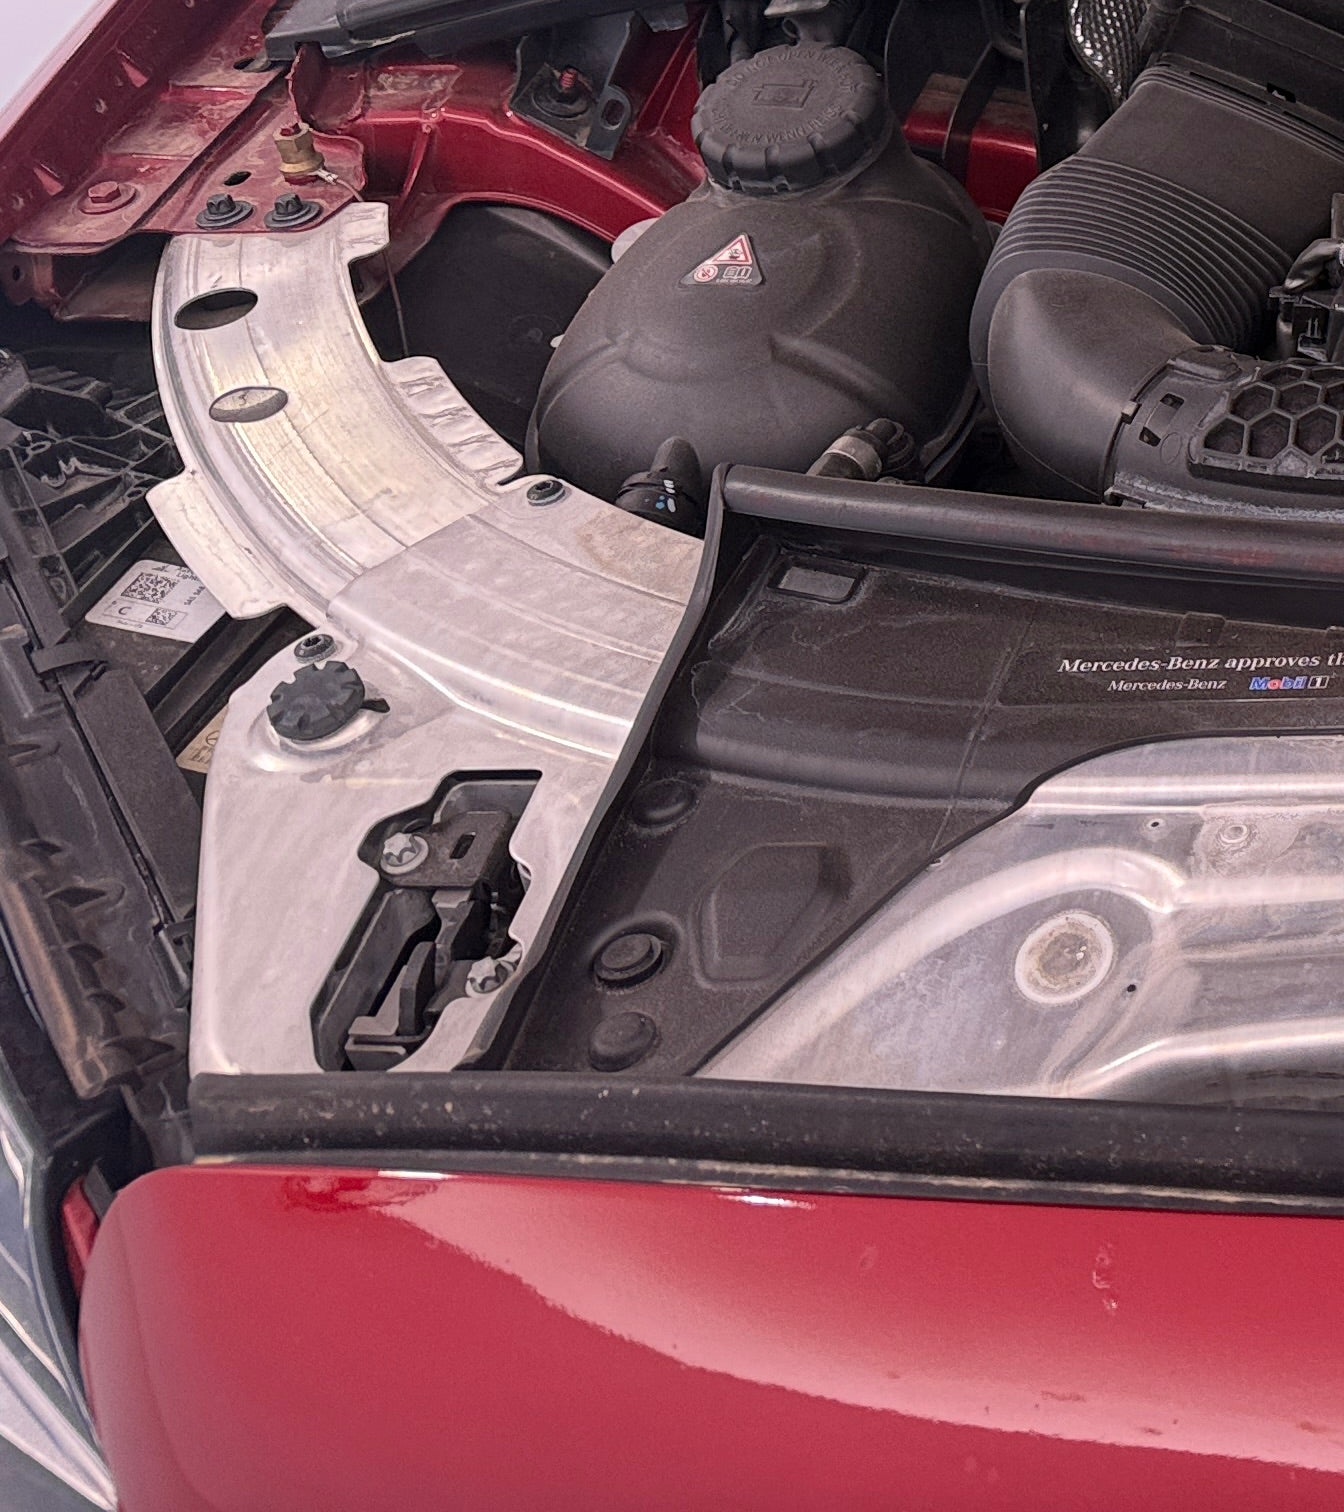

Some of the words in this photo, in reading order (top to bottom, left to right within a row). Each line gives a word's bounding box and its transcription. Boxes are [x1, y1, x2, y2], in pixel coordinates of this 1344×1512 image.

[1057, 656, 1220, 673] Mercedes-Benz
[1224, 655, 1321, 672] approves
[1107, 678, 1227, 692] Mercedes-Benz
[1249, 676, 1308, 690] Mobil
